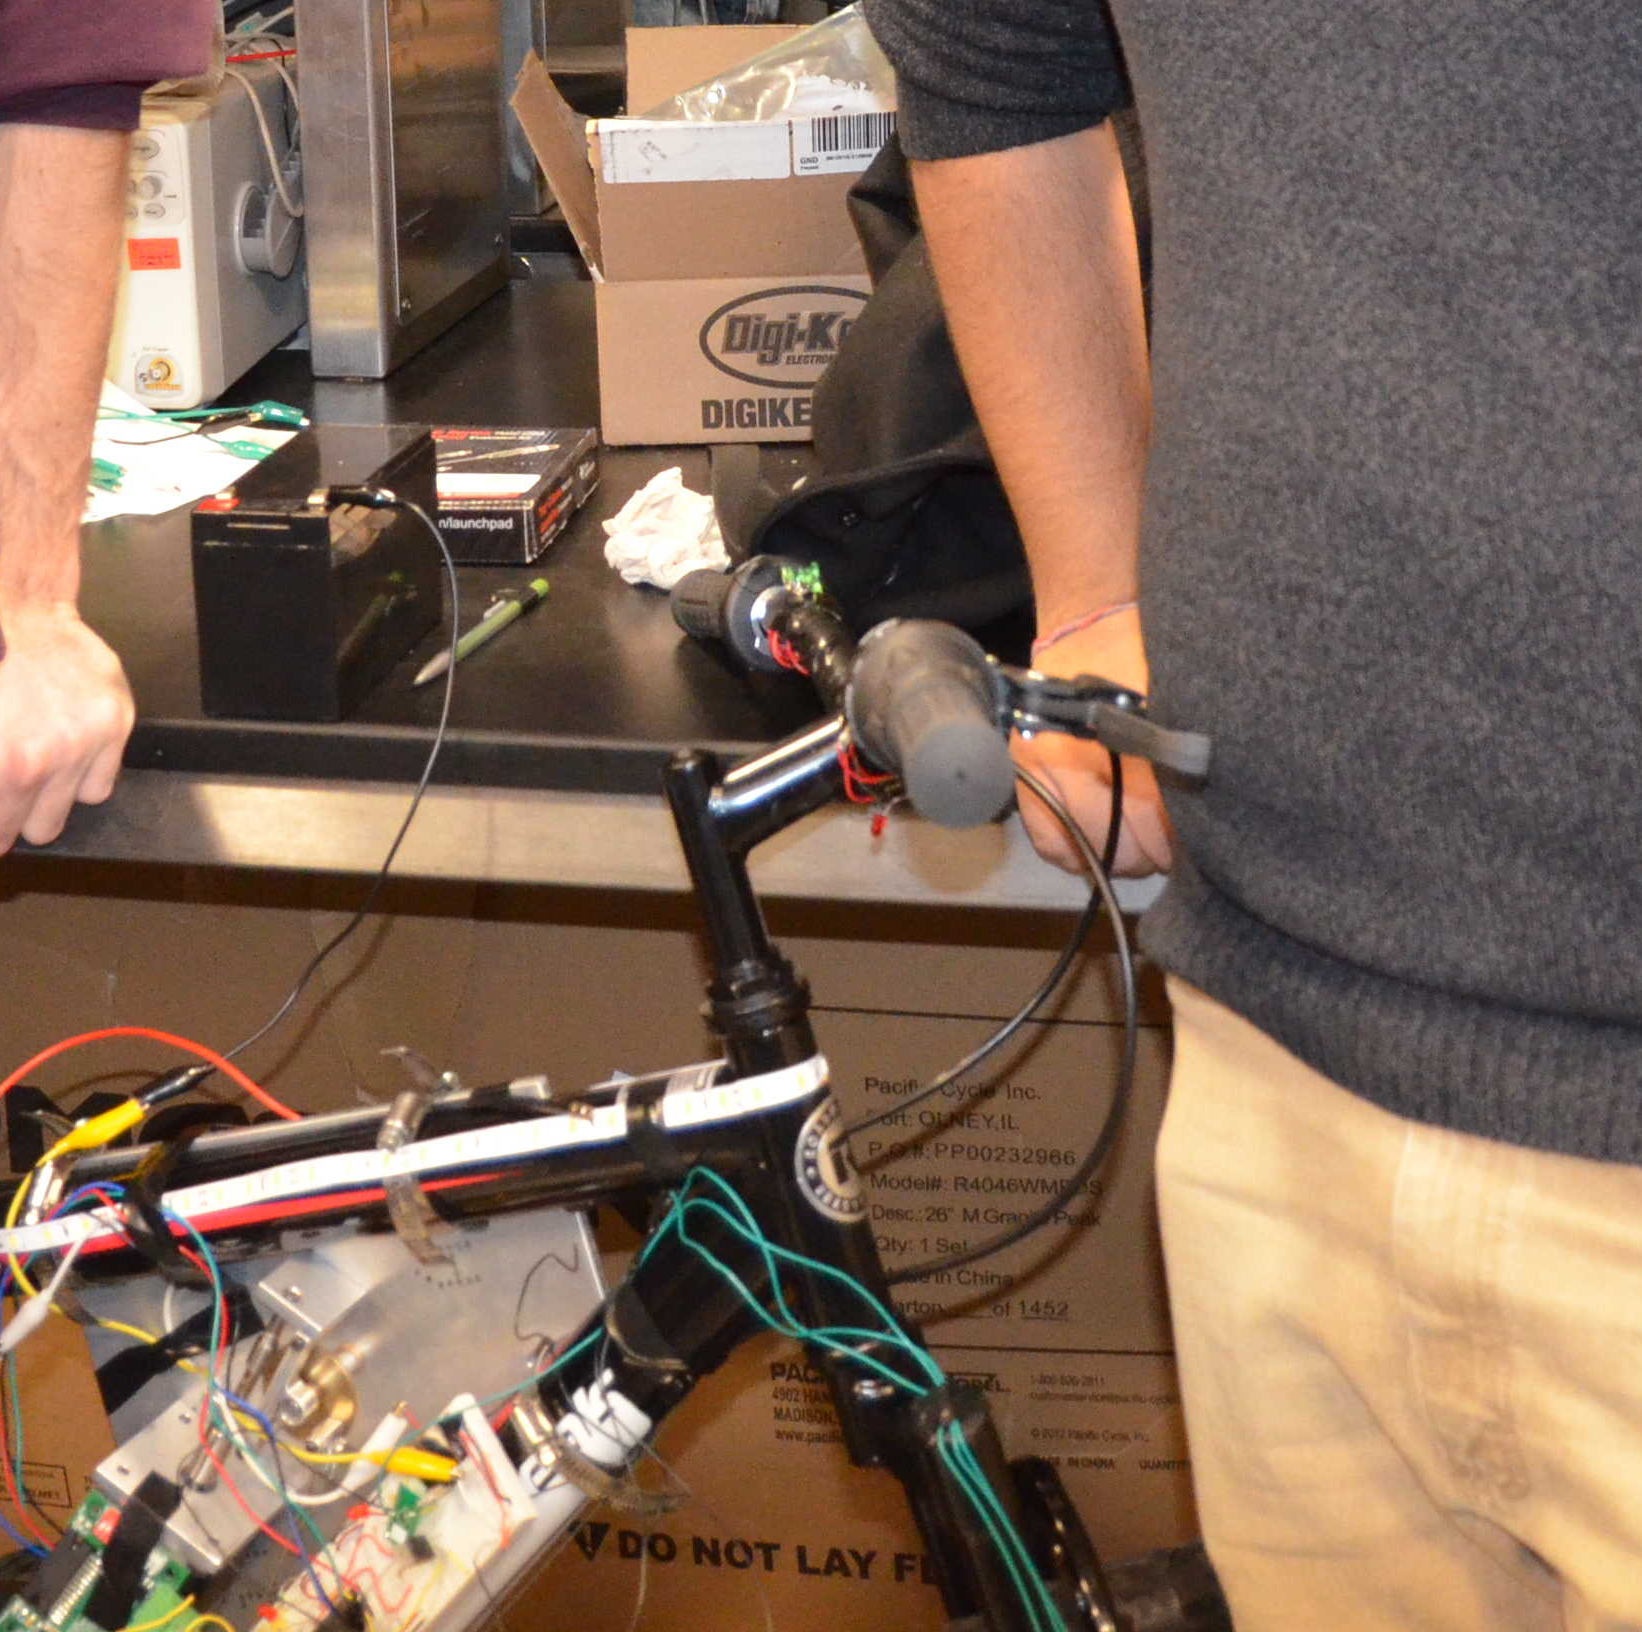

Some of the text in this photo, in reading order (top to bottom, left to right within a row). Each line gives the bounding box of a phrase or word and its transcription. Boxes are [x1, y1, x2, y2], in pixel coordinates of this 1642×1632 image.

[800, 156, 818, 164] GND
[701, 397, 813, 429] DIGIKE
[865, 1077, 1042, 1102] Pacifi Cycle Inc.
[865, 1109, 913, 1128] ort:
[934, 1143, 1077, 1166] PP00232966
[953, 1176, 1103, 1197] R4046WMS
[963, 1208, 980, 1223] M
[983, 1209, 1038, 1225] Grani
[1054, 1211, 1102, 1227] Peak
[874, 1236, 968, 1256] Qty: 1 Set
[957, 1270, 1014, 1286] China
[893, 1299, 1070, 1317] arton of 1452
[770, 1362, 825, 1384] PAC
[772, 1386, 800, 1402] 4902
[1081, 1457, 1116, 1469] CHINA
[618, 1530, 677, 1563] DO
[692, 1535, 781, 1572] NOT
[796, 1545, 877, 1580] LAY
